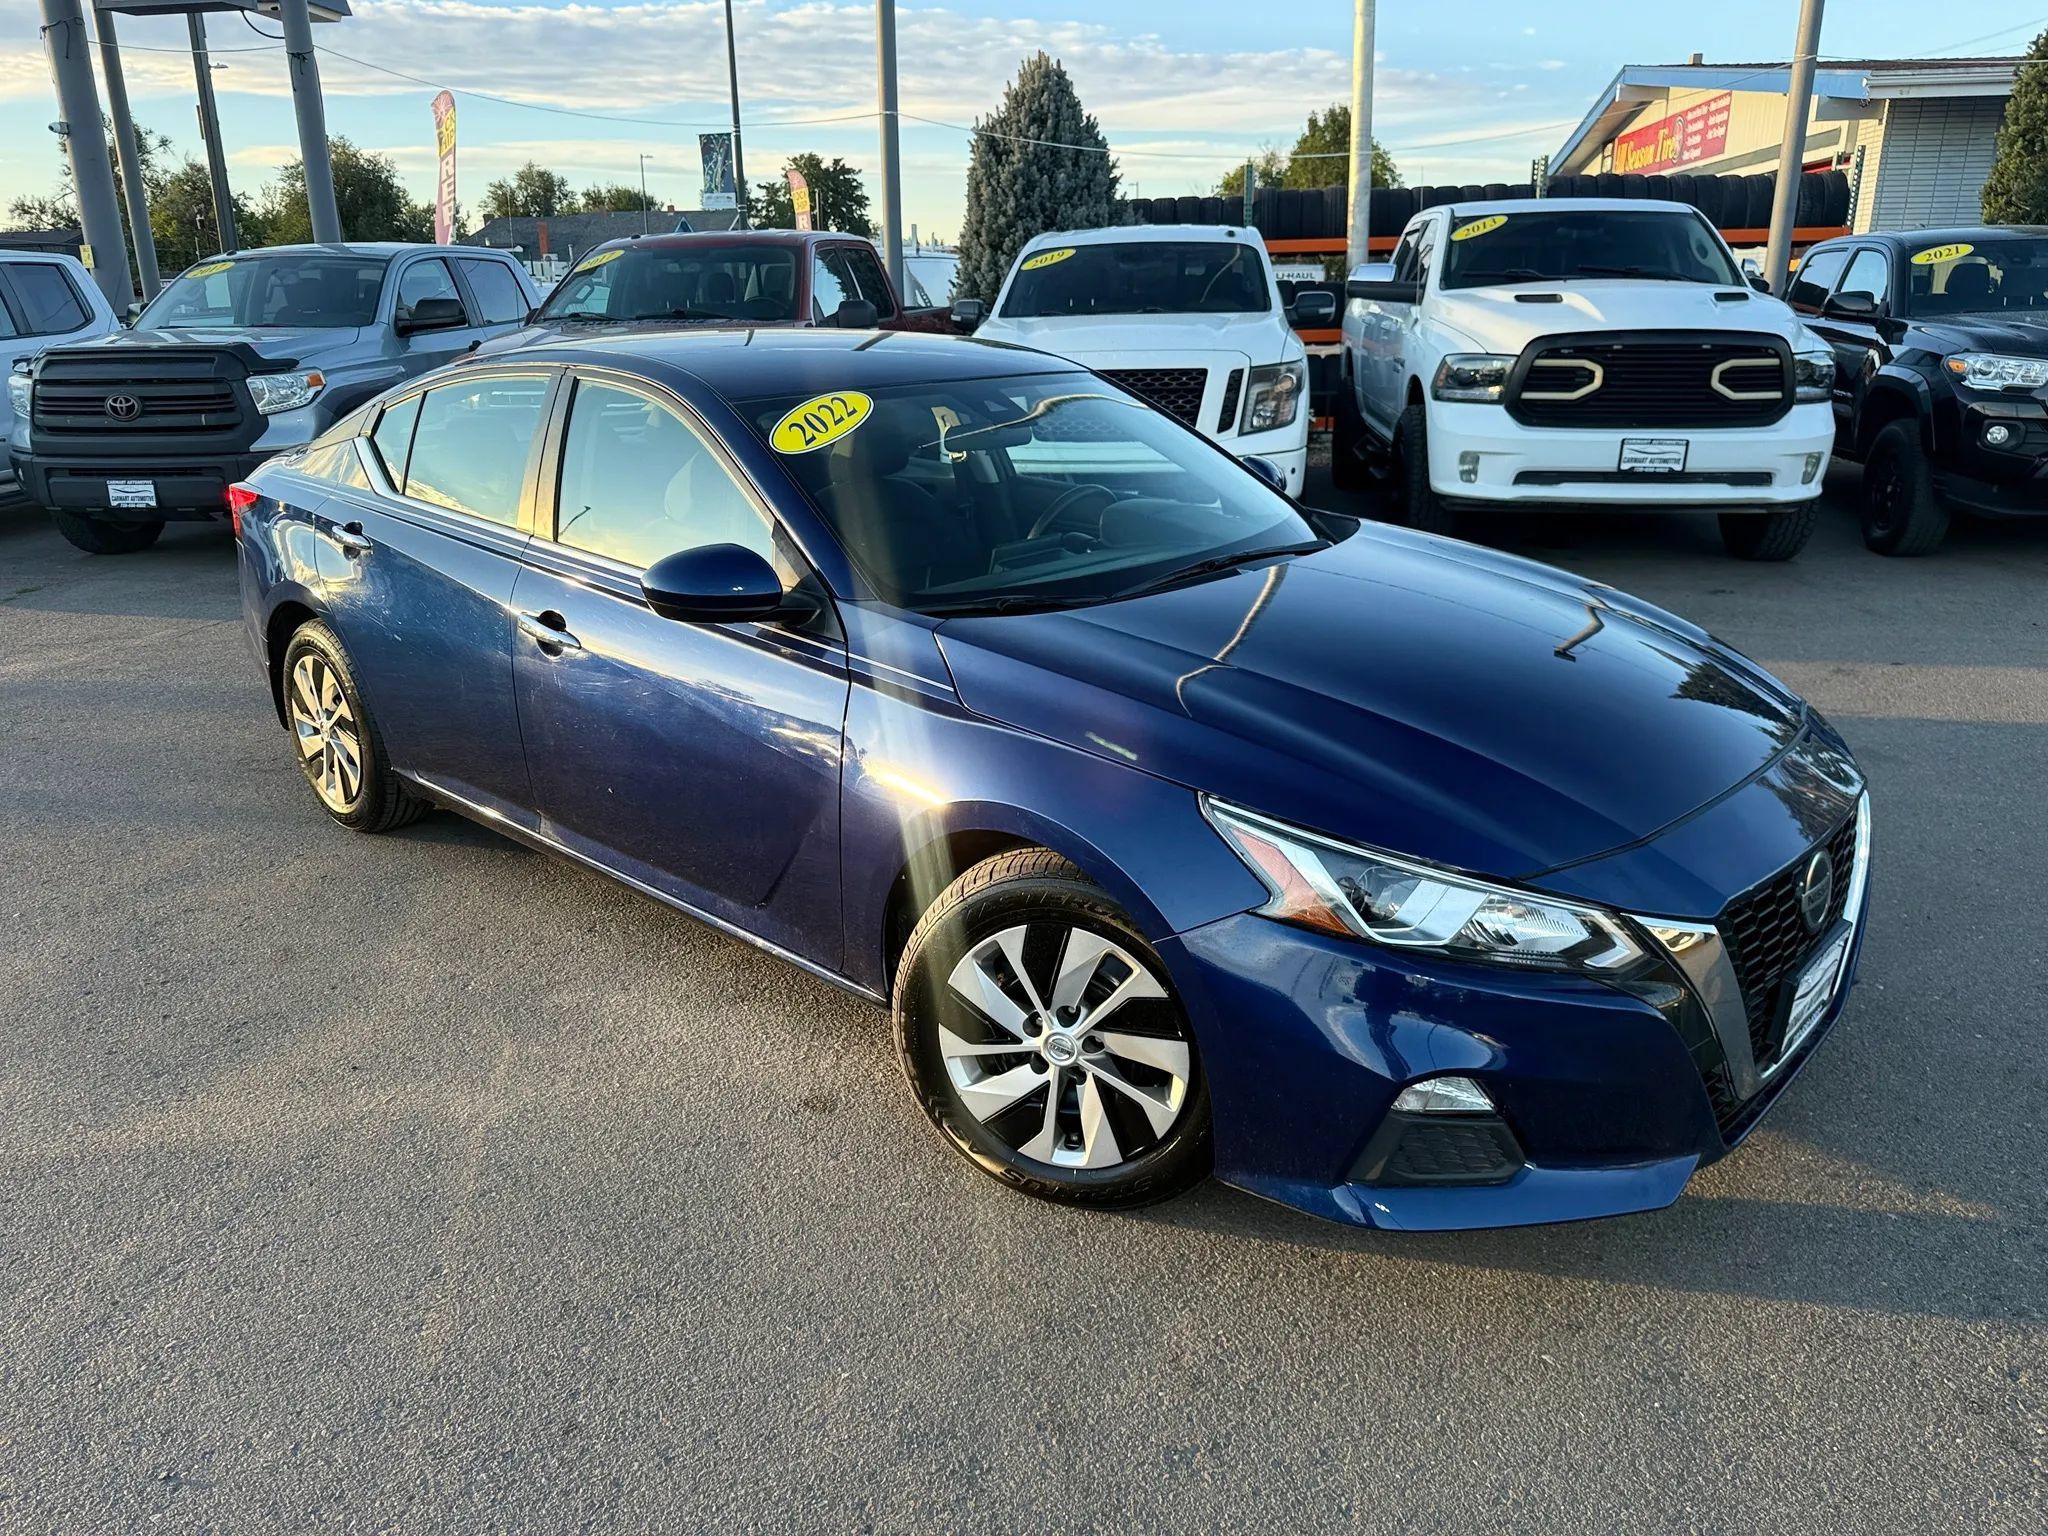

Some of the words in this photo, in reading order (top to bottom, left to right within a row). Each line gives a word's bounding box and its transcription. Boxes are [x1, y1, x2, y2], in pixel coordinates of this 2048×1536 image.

[1625, 141, 1655, 171] Season
[1032, 252, 1065, 267] 2019
[1924, 245, 1960, 262] 2021
[788, 396, 858, 447] 2022
